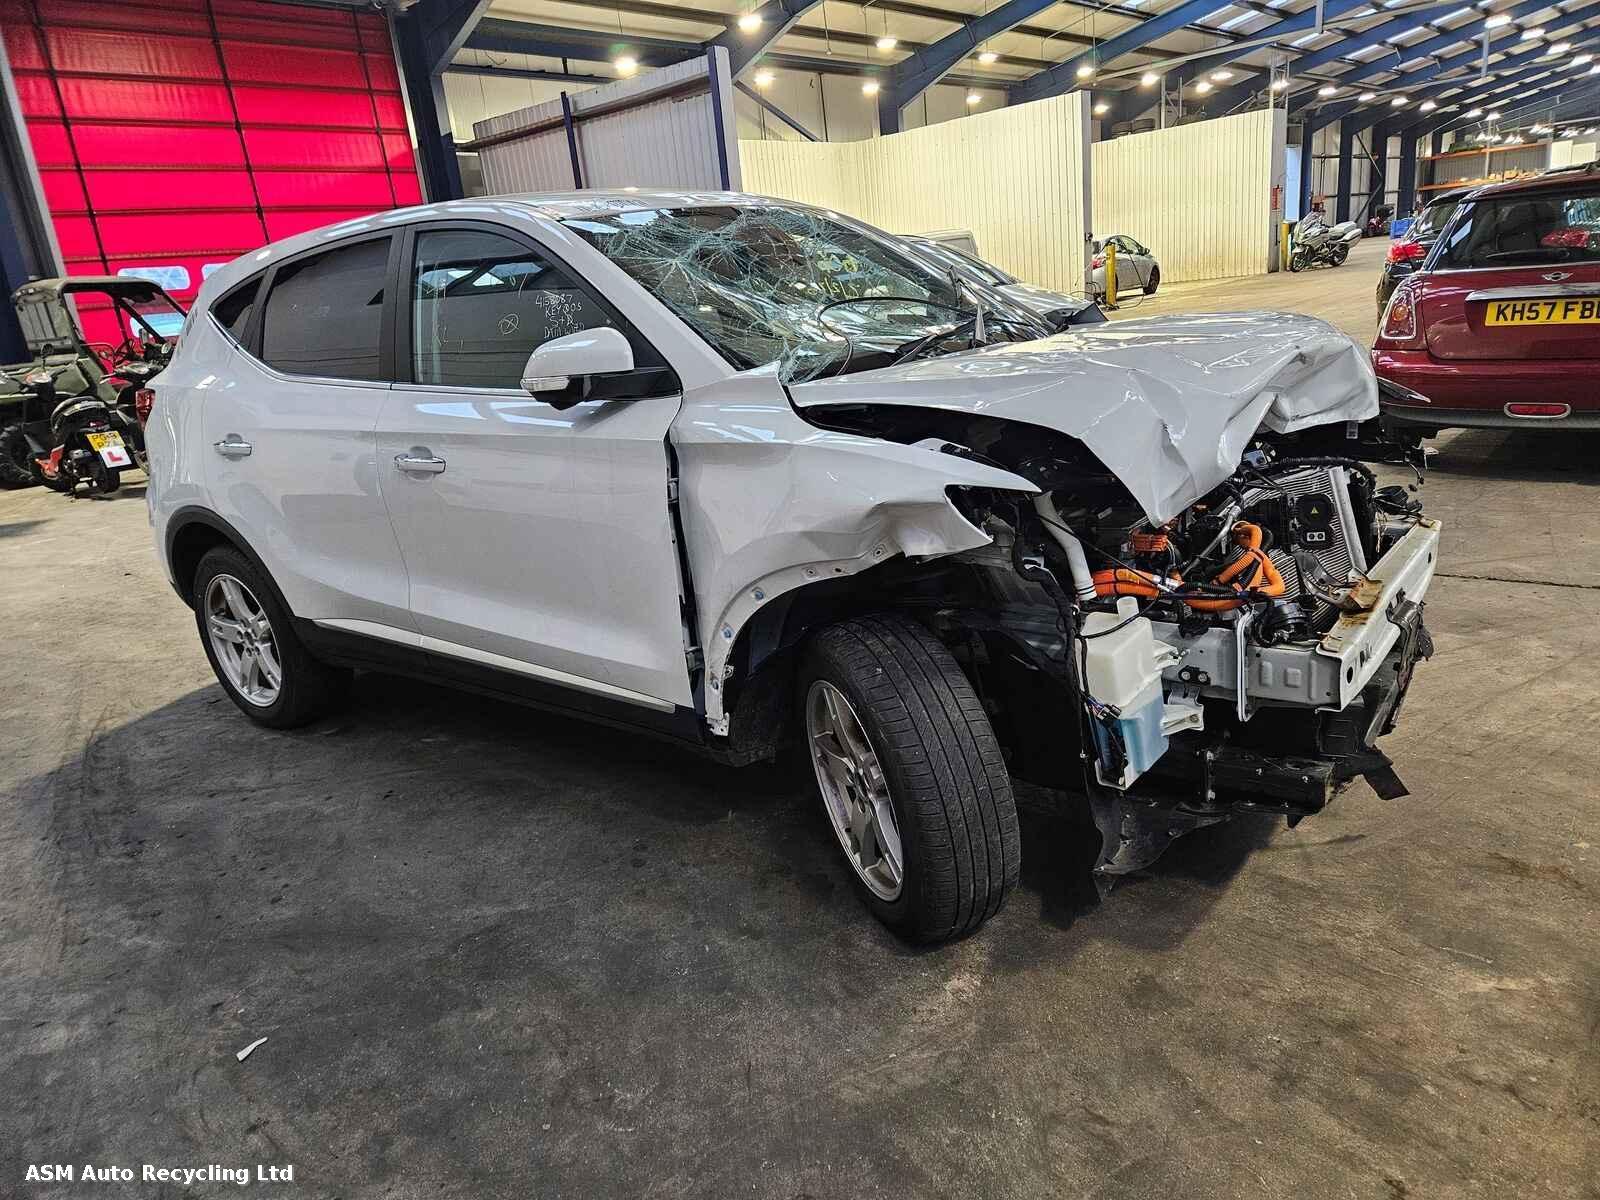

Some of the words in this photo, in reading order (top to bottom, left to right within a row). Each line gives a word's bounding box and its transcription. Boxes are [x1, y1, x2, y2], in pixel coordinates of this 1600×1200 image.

[1495, 302, 1557, 321] KH57
[1562, 300, 1600, 320] FB
[107, 451, 123, 462] L
